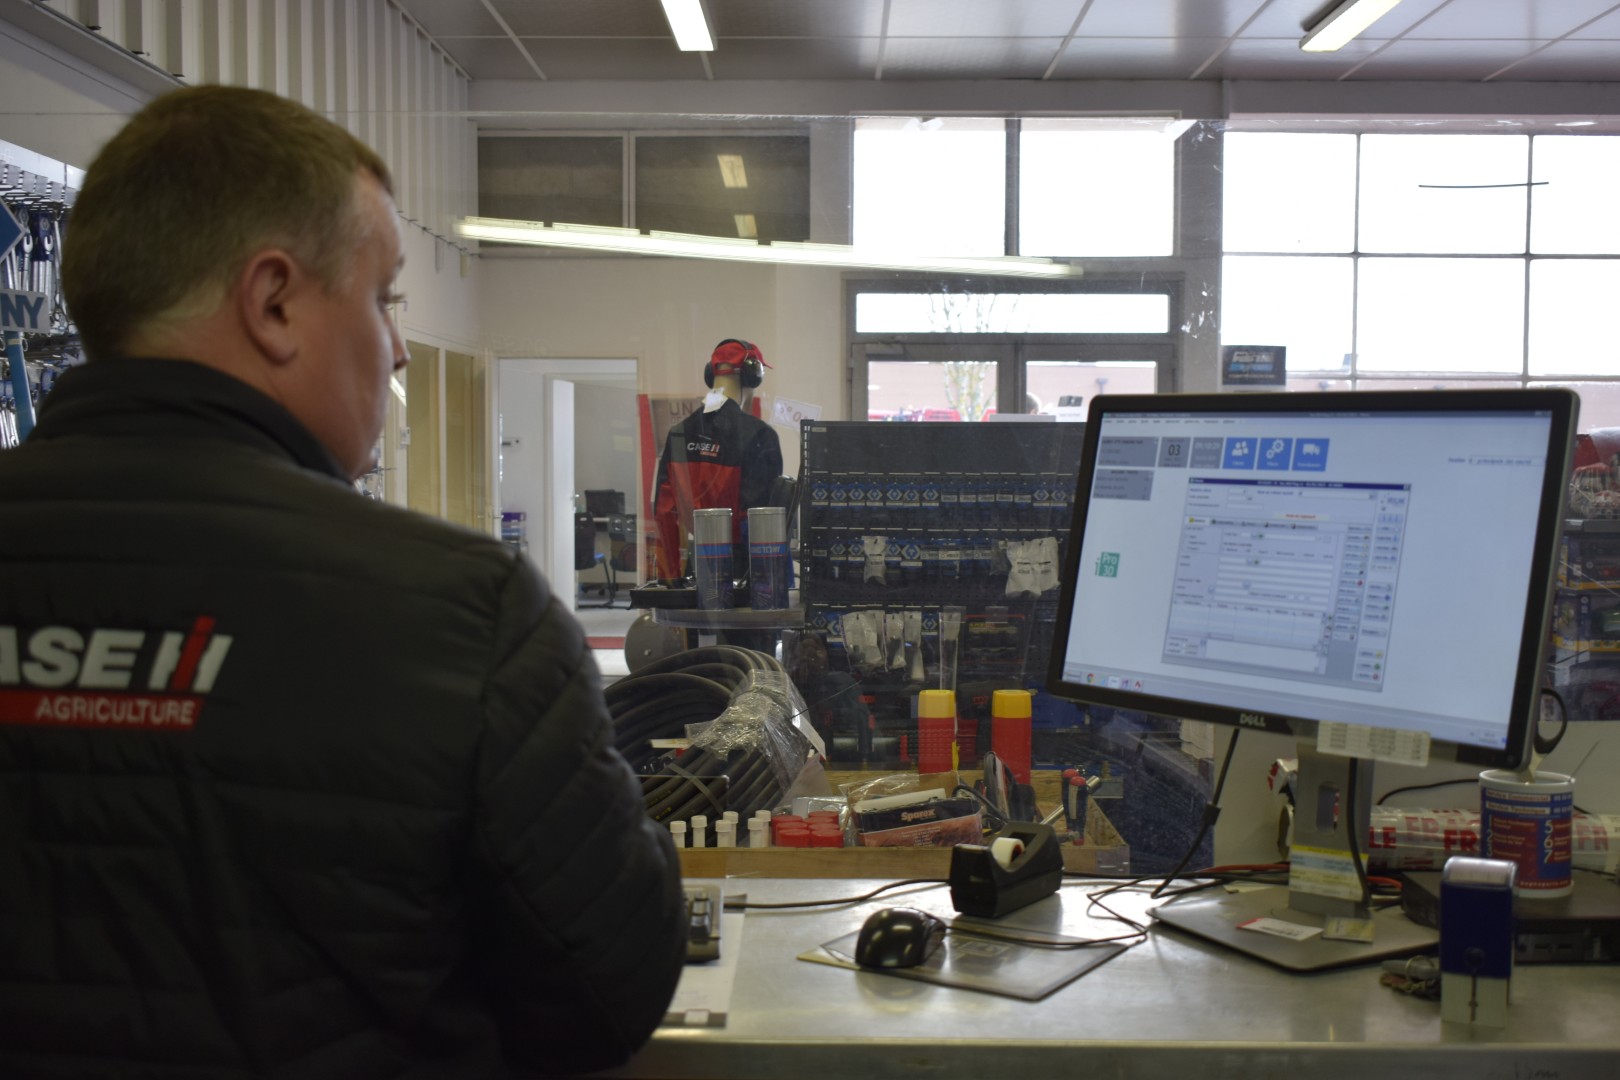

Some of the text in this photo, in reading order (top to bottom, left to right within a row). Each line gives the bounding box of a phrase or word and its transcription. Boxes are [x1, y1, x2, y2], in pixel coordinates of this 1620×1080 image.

[0, 293, 44, 329] NY
[687, 442, 711, 452] CASE
[1168, 444, 1181, 456] 03
[36, 696, 196, 725] AGRICULTURE
[1239, 713, 1267, 727] DELL
[901, 808, 936, 822] Sparex
[1544, 819, 1554, 834] 5
[1543, 835, 1554, 849] 6
[1544, 849, 1553, 864] 7
